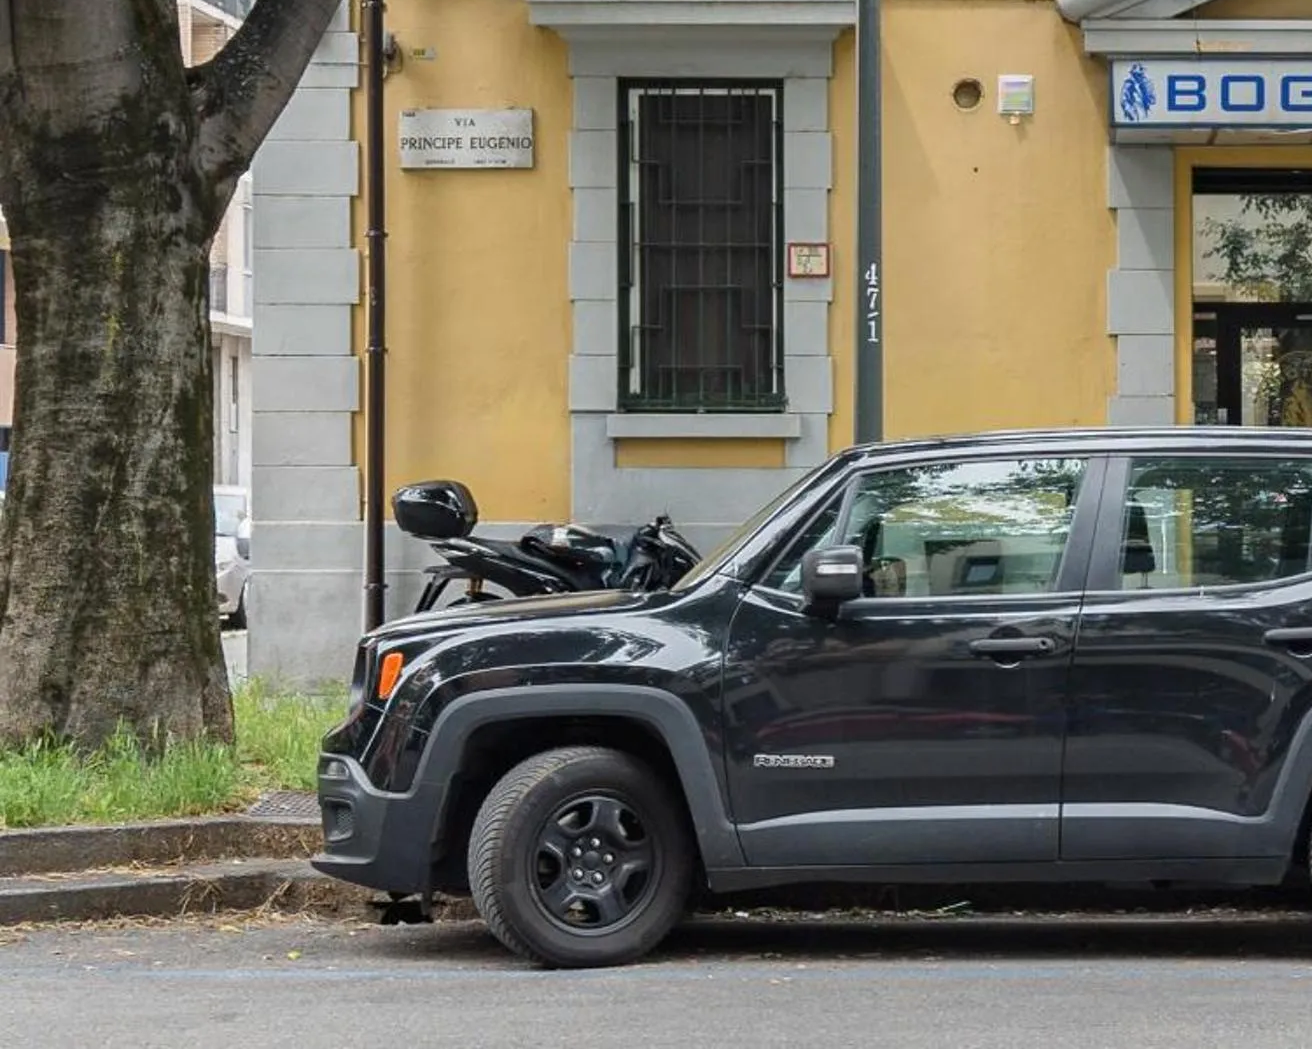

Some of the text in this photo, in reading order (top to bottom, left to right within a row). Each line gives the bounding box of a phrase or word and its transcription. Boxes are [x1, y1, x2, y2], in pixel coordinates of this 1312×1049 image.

[454, 117, 477, 127] VIA
[400, 137, 533, 150] PRINCIPE EUGENIO
